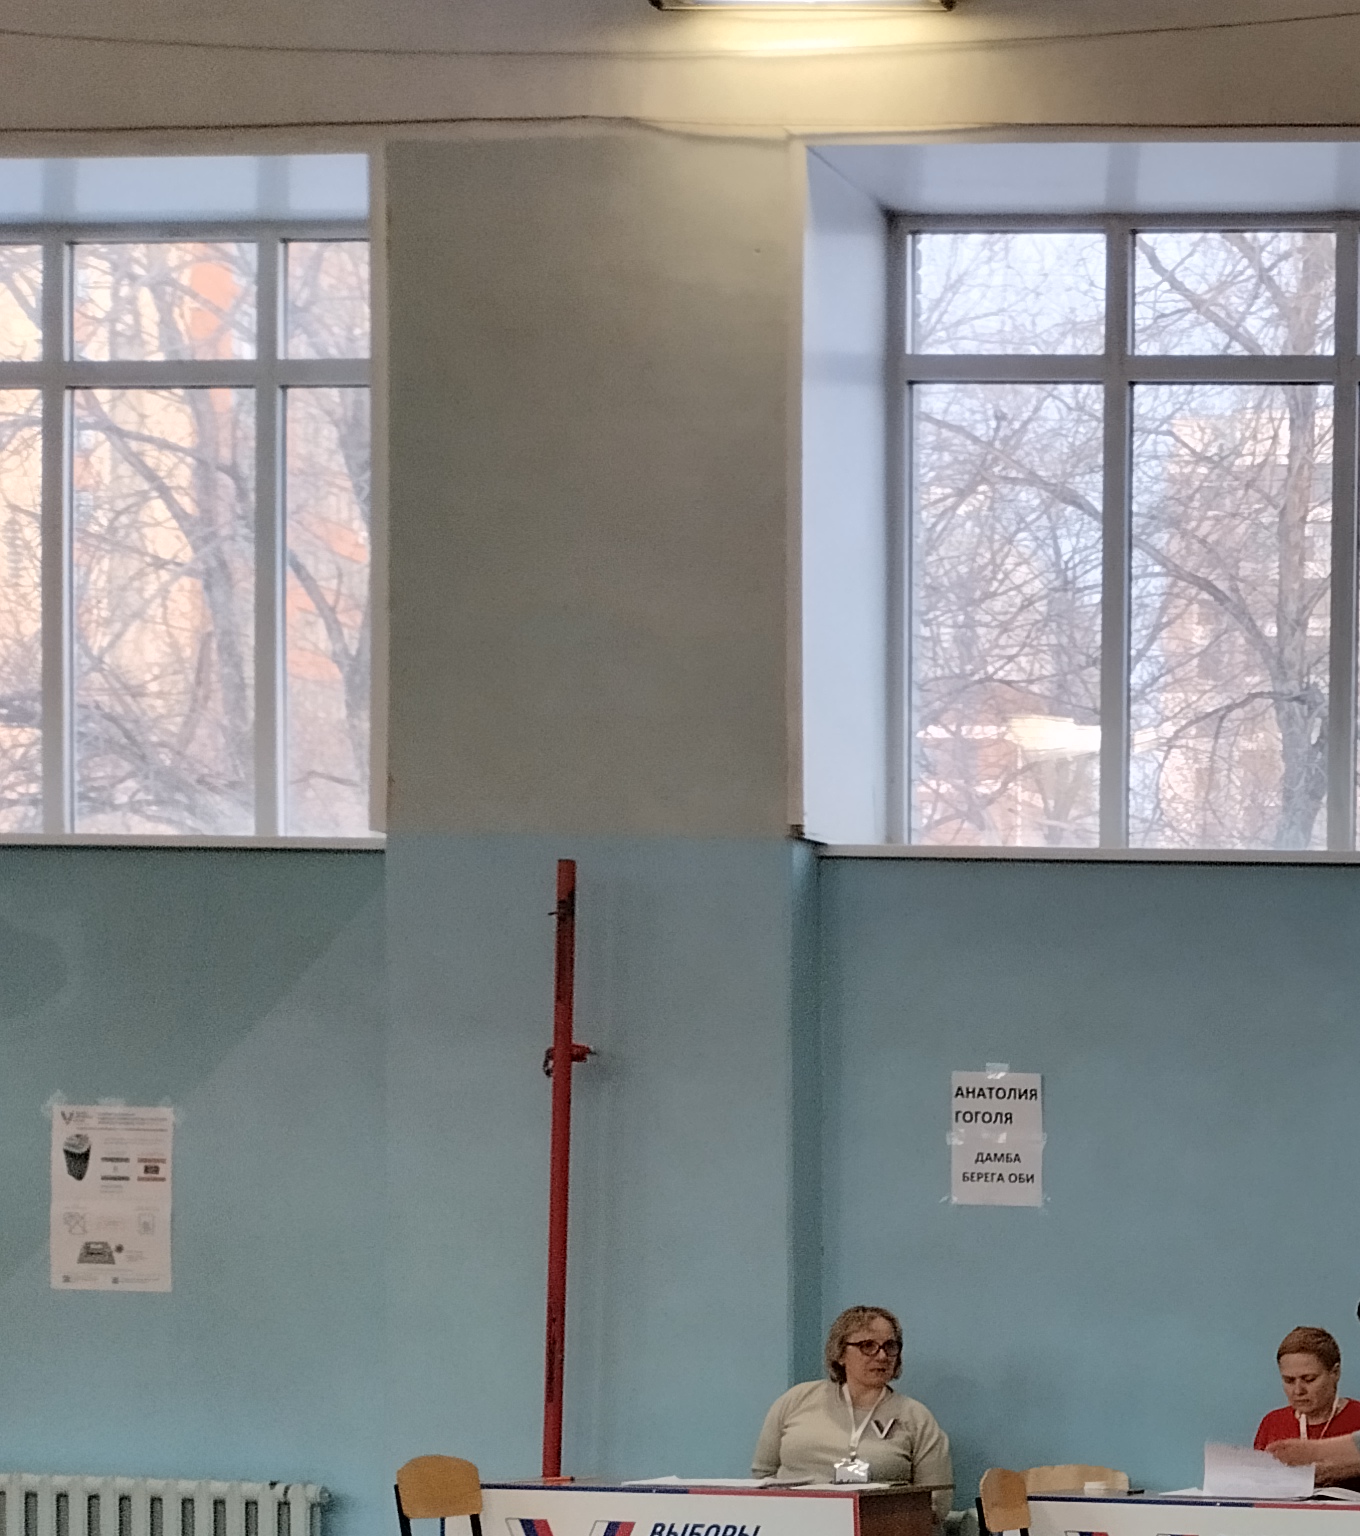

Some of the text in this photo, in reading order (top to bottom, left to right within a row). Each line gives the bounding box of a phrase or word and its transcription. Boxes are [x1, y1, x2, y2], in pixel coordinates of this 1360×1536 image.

[954, 1085, 1038, 1101] АНАТОЛИЯ
[954, 1110, 1013, 1124] ГОГОЛЯ
[974, 1152, 1021, 1164] ДАМБА
[962, 1171, 1035, 1184] БЕРЕГА ОБИ
